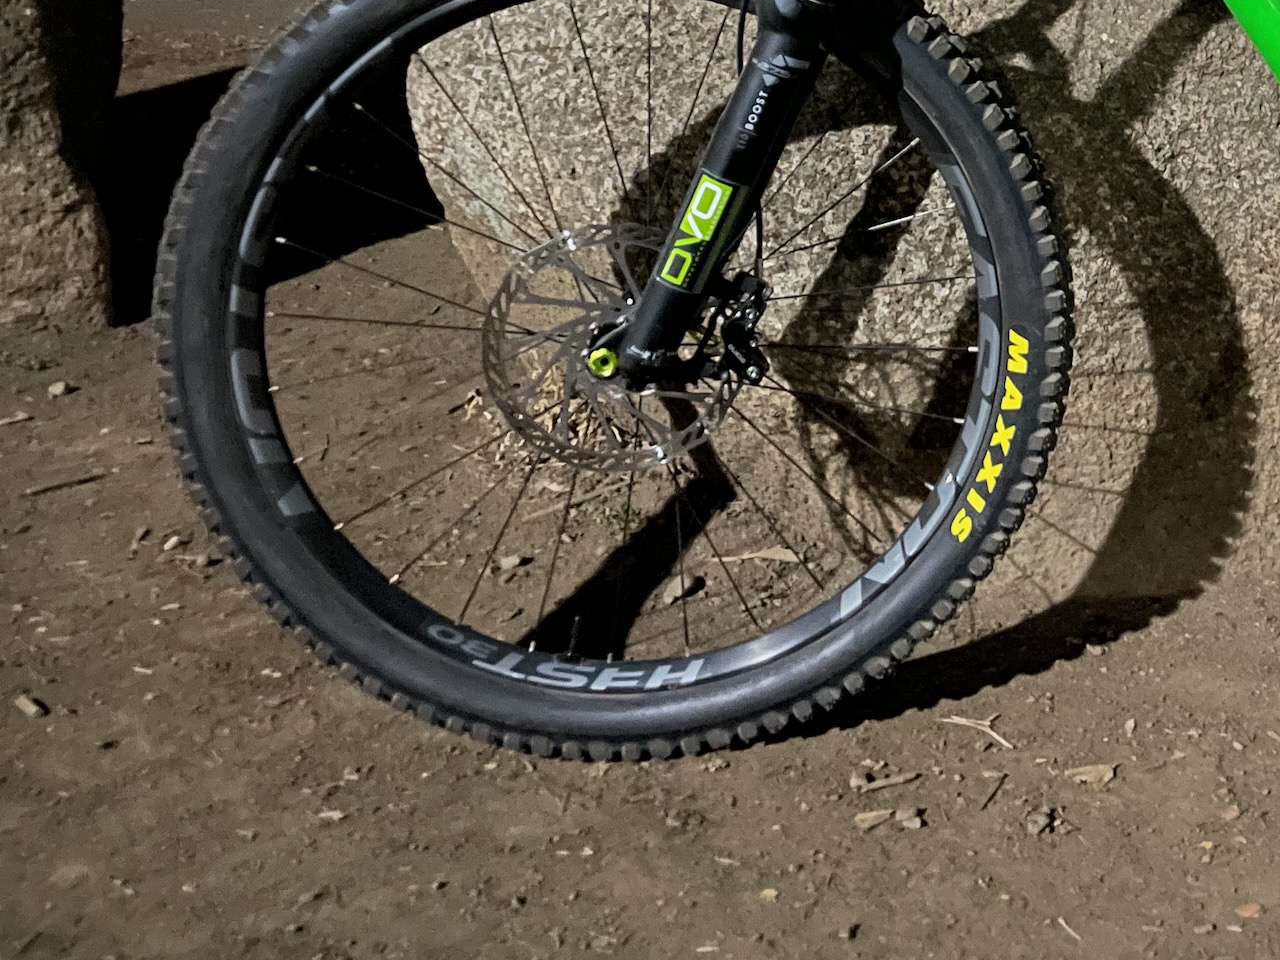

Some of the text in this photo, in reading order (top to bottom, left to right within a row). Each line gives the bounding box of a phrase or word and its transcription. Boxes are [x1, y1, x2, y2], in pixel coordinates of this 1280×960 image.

[744, 90, 769, 131] BOOST
[660, 180, 723, 286] DVO
[951, 329, 1029, 543] MAXXIS
